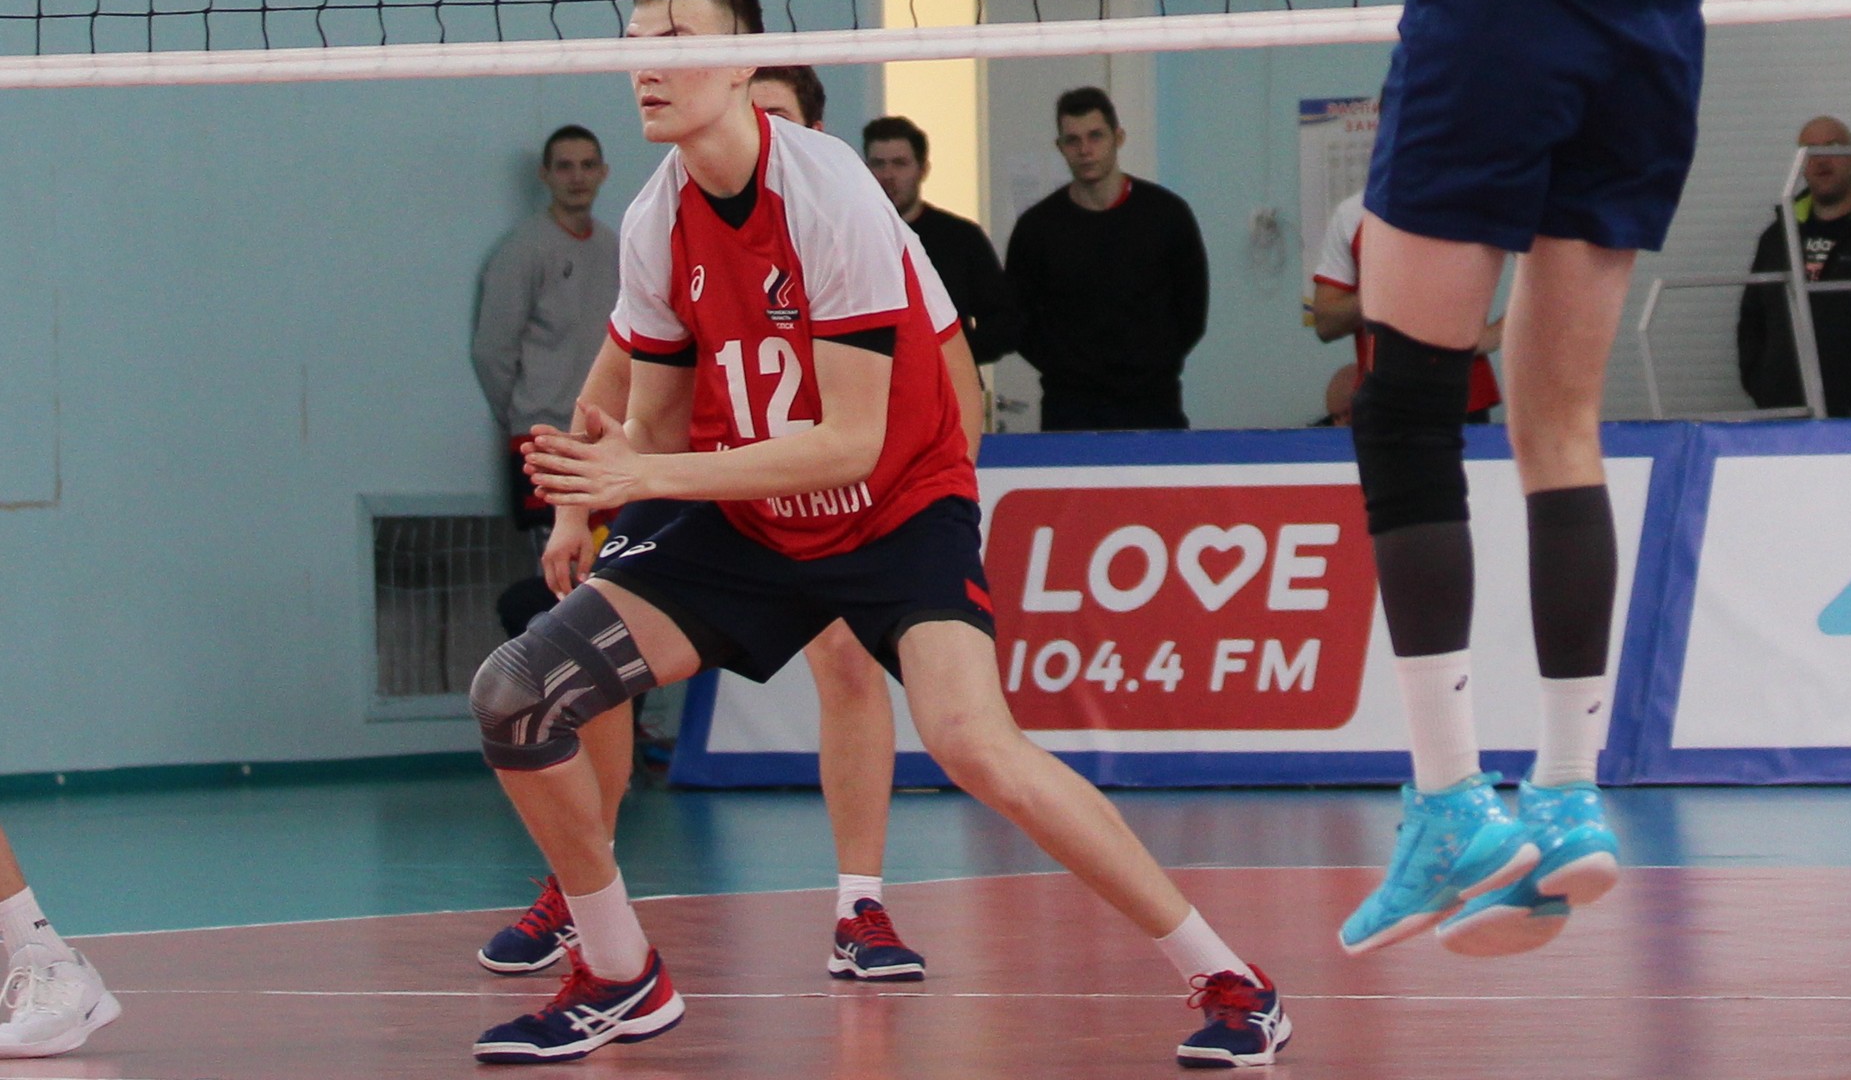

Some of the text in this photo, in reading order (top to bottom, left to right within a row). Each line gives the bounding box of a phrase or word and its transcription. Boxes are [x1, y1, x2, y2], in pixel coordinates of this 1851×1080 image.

[715, 336, 816, 439] 12
[1007, 638, 1322, 692] 104.4 FM
